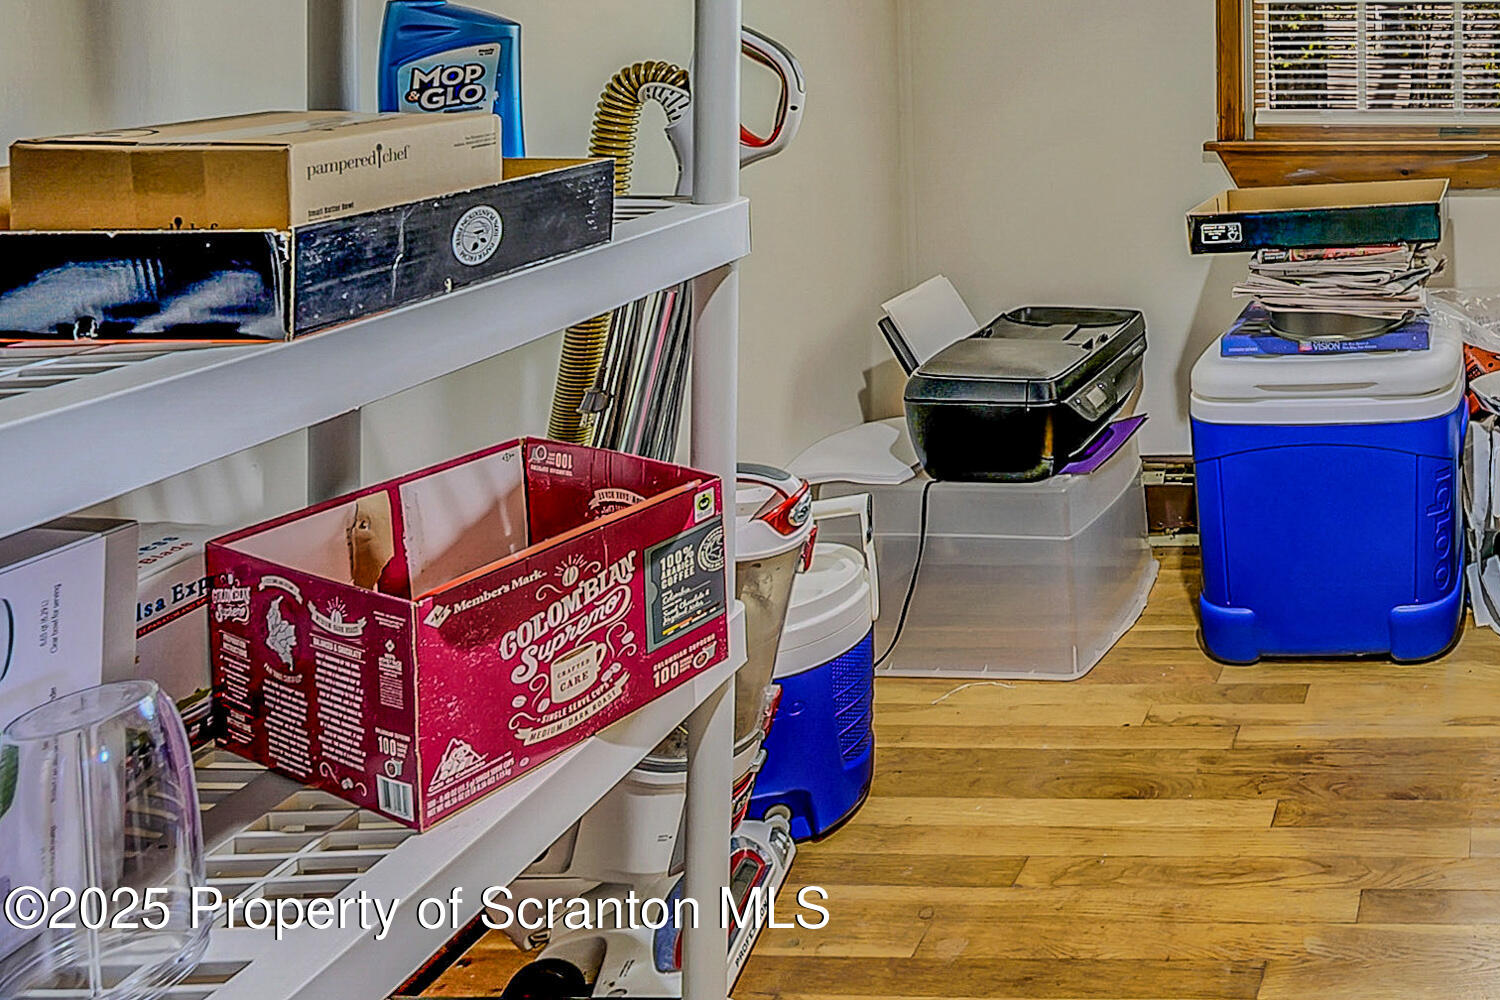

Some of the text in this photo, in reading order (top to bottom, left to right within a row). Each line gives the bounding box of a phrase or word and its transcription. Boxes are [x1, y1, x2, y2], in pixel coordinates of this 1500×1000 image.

[412, 63, 484, 90] MOP
[406, 84, 484, 110] & GLO
[307, 145, 410, 180] pampered chef
[1312, 341, 1341, 351] VISION
[659, 544, 695, 571] 100%
[660, 558, 695, 580] ARABICA
[661, 566, 695, 590] COFFEE
[453, 570, 547, 615] Member's Mark
[499, 550, 637, 660] COLOMBIAN
[510, 590, 632, 685] Supremo
[556, 658, 591, 679] CRAFTED
[559, 670, 590, 693] CARE
[653, 661, 680, 688] 100
[541, 706, 568, 724] SINGLE
[567, 696, 592, 715] SERVE
[592, 689, 618, 712] ROAST
[377, 735, 396, 757] 100
